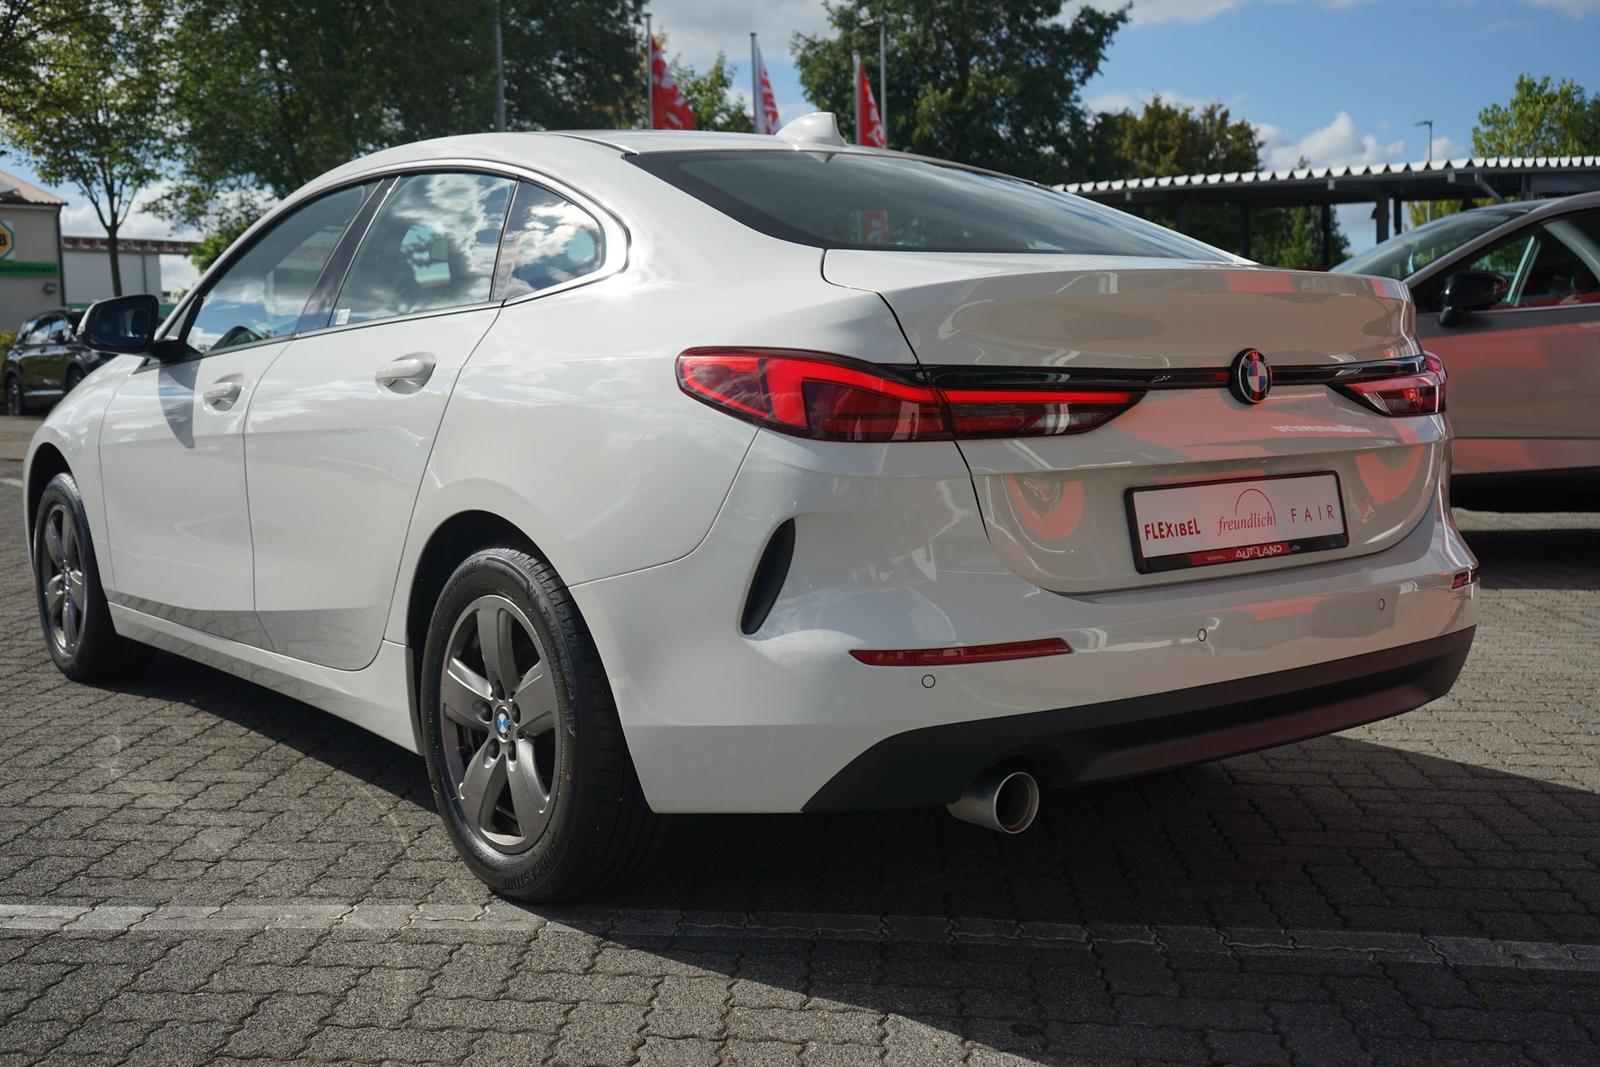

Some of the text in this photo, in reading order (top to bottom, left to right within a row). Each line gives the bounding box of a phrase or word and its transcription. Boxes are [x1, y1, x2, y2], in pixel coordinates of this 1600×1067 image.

[1144, 504, 1335, 541] FLEXIBEL freundlich FAIR
